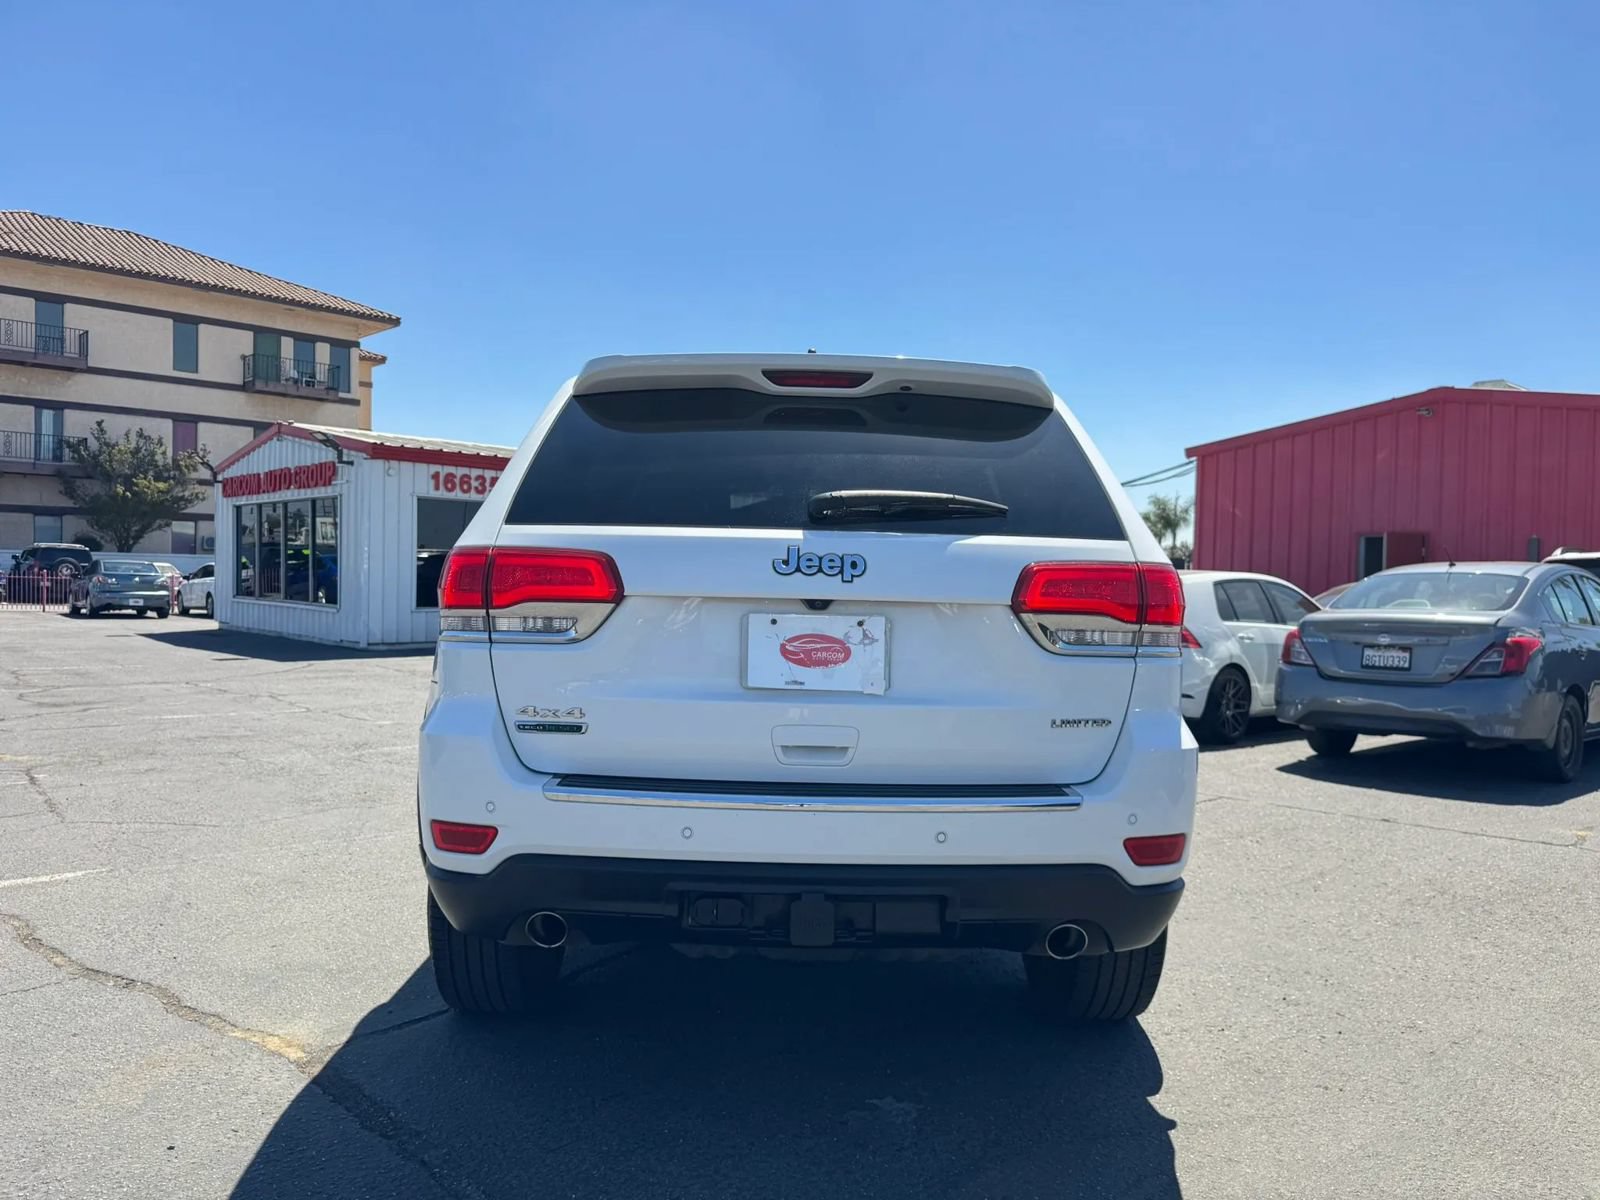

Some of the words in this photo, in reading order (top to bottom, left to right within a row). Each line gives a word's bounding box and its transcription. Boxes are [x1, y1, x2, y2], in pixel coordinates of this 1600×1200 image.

[223, 473, 260, 497] CARCOM
[260, 468, 291, 493] AUTO
[292, 461, 336, 489] GROUP
[772, 544, 867, 583] Jeep
[811, 651, 845, 659] CARCOM
[516, 705, 586, 719] 4x4
[1051, 718, 1112, 728] LIMITED
